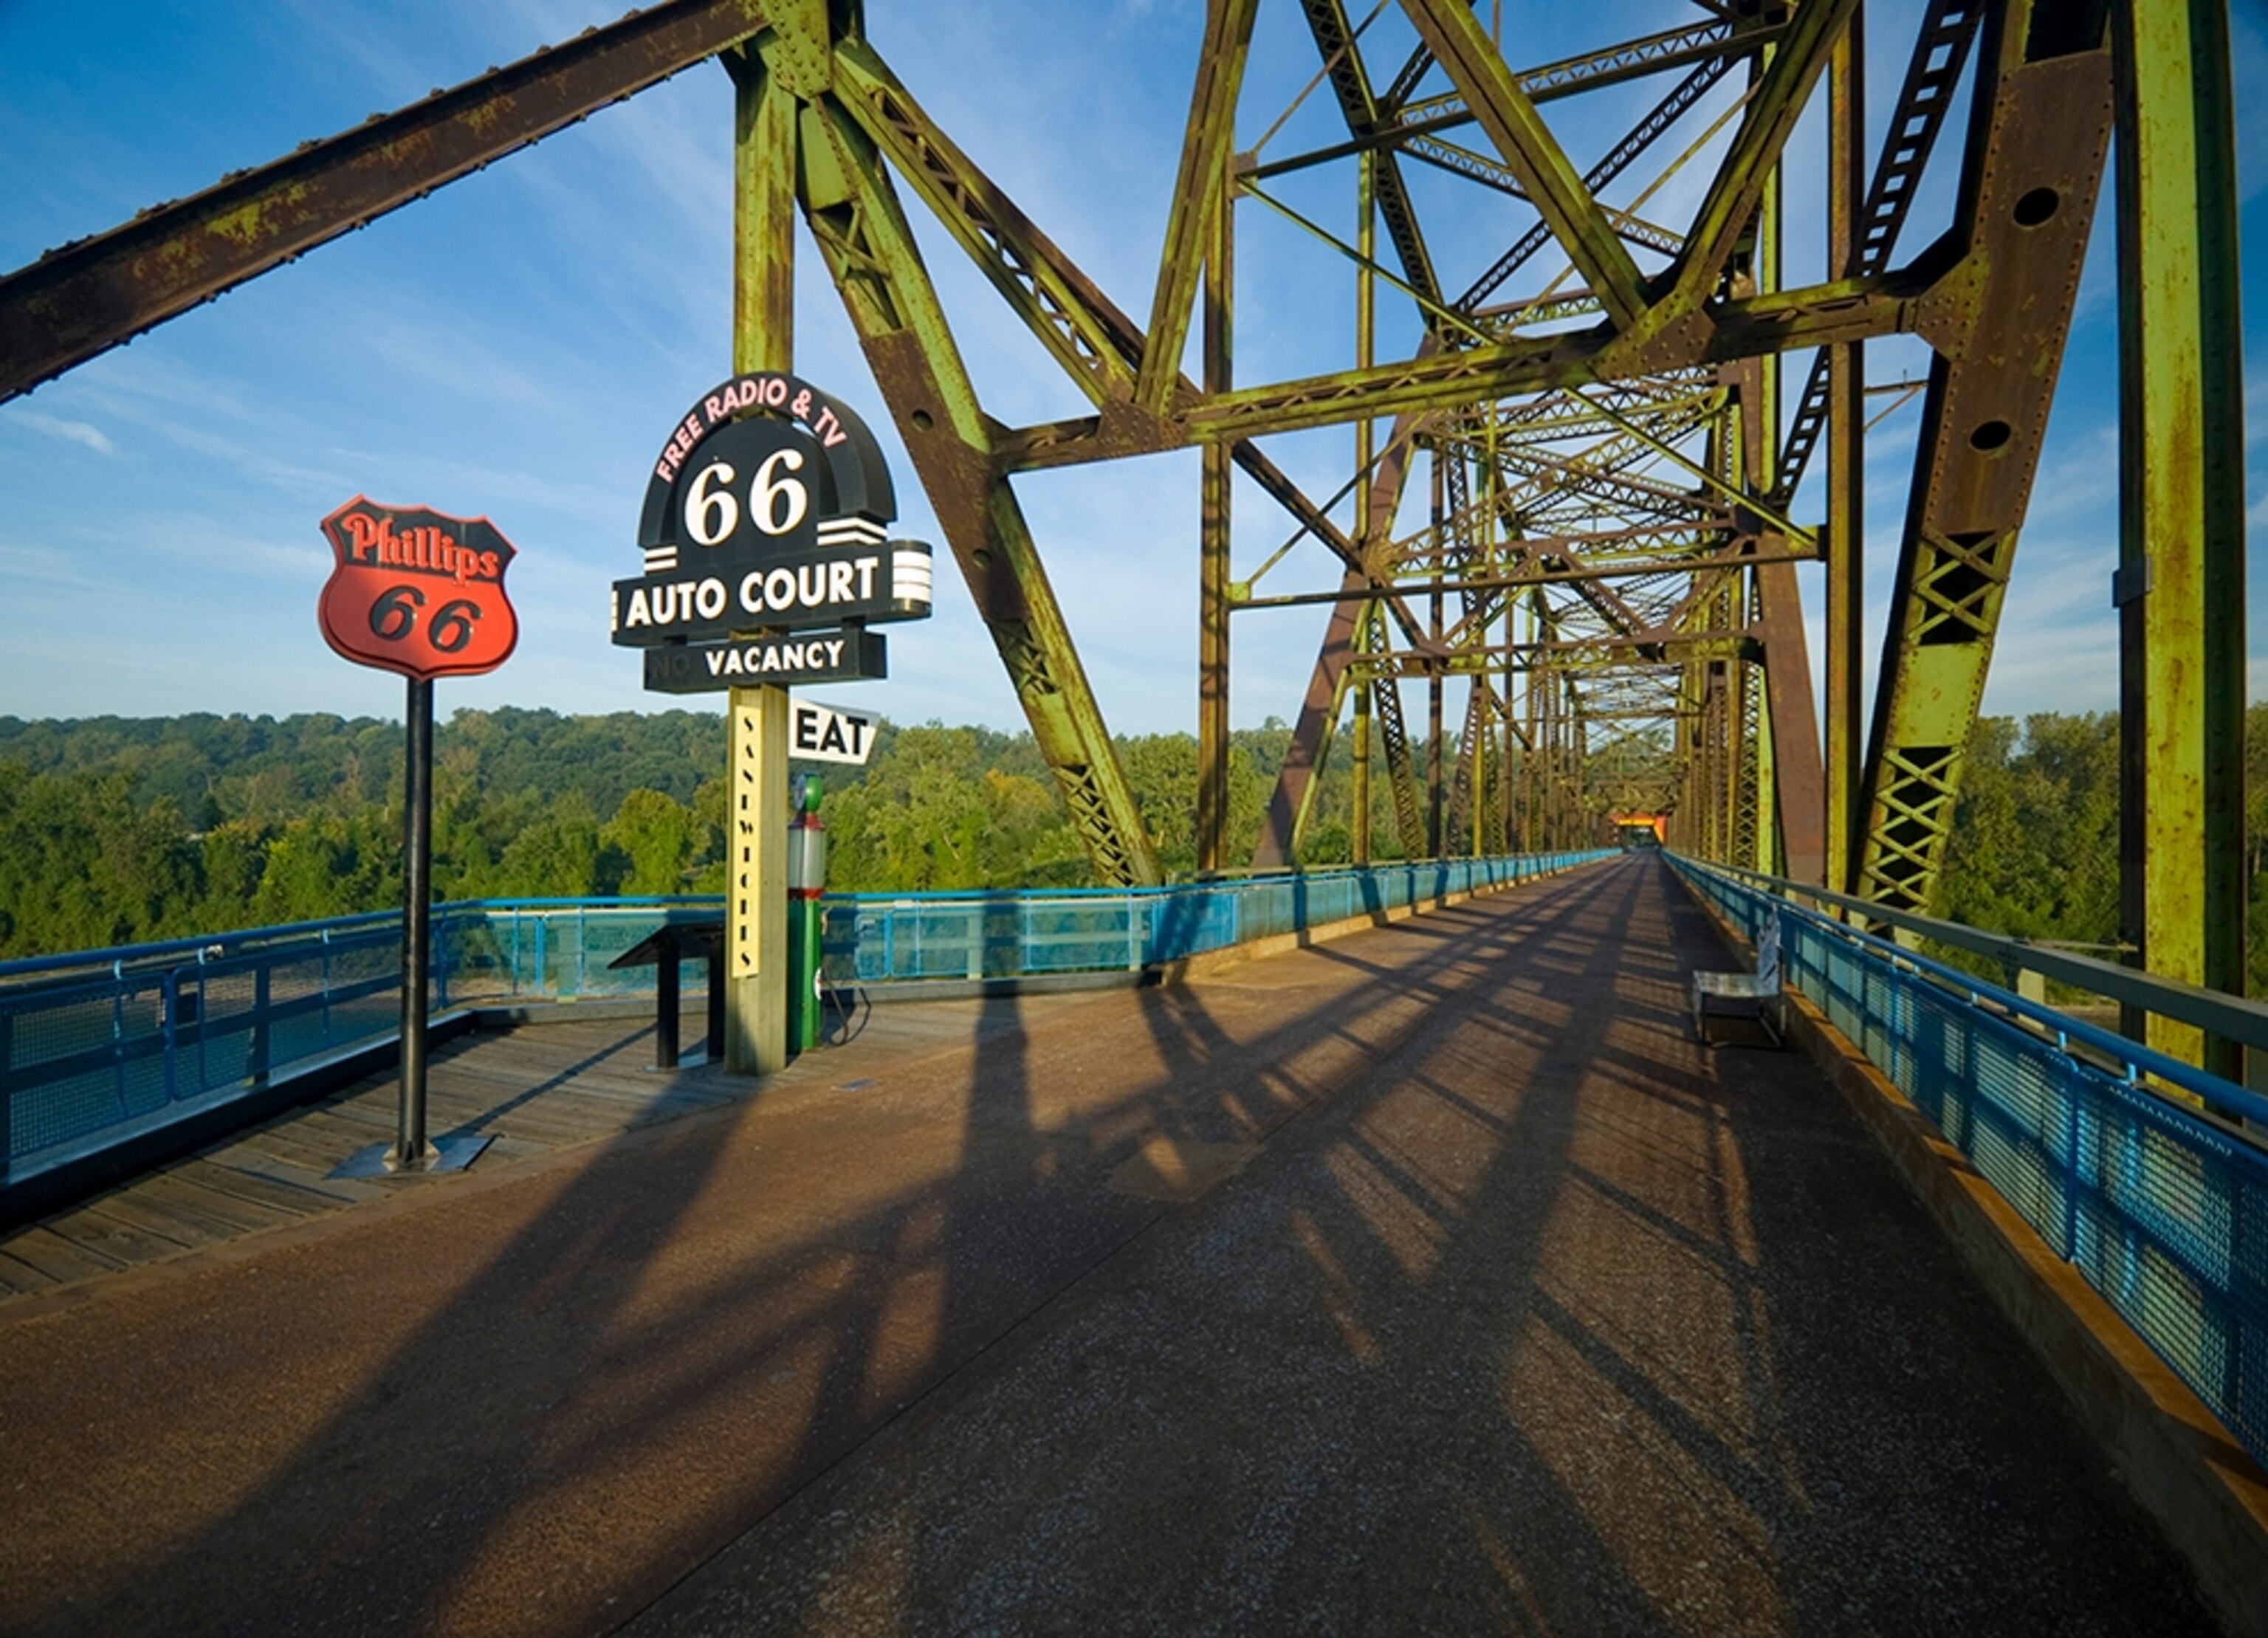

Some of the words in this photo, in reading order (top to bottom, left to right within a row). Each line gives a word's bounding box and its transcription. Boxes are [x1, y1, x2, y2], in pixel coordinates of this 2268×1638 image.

[656, 414, 704, 484] FREE
[704, 377, 788, 423] RADIO
[791, 388, 813, 419] &
[813, 407, 848, 449] TV
[684, 449, 808, 546] 66
[340, 512, 501, 587] Phillips
[369, 584, 483, 654] 66
[625, 578, 727, 627] AUTO
[739, 557, 879, 613] COURT
[705, 640, 845, 675] VACANCY
[797, 708, 868, 755] EAT
